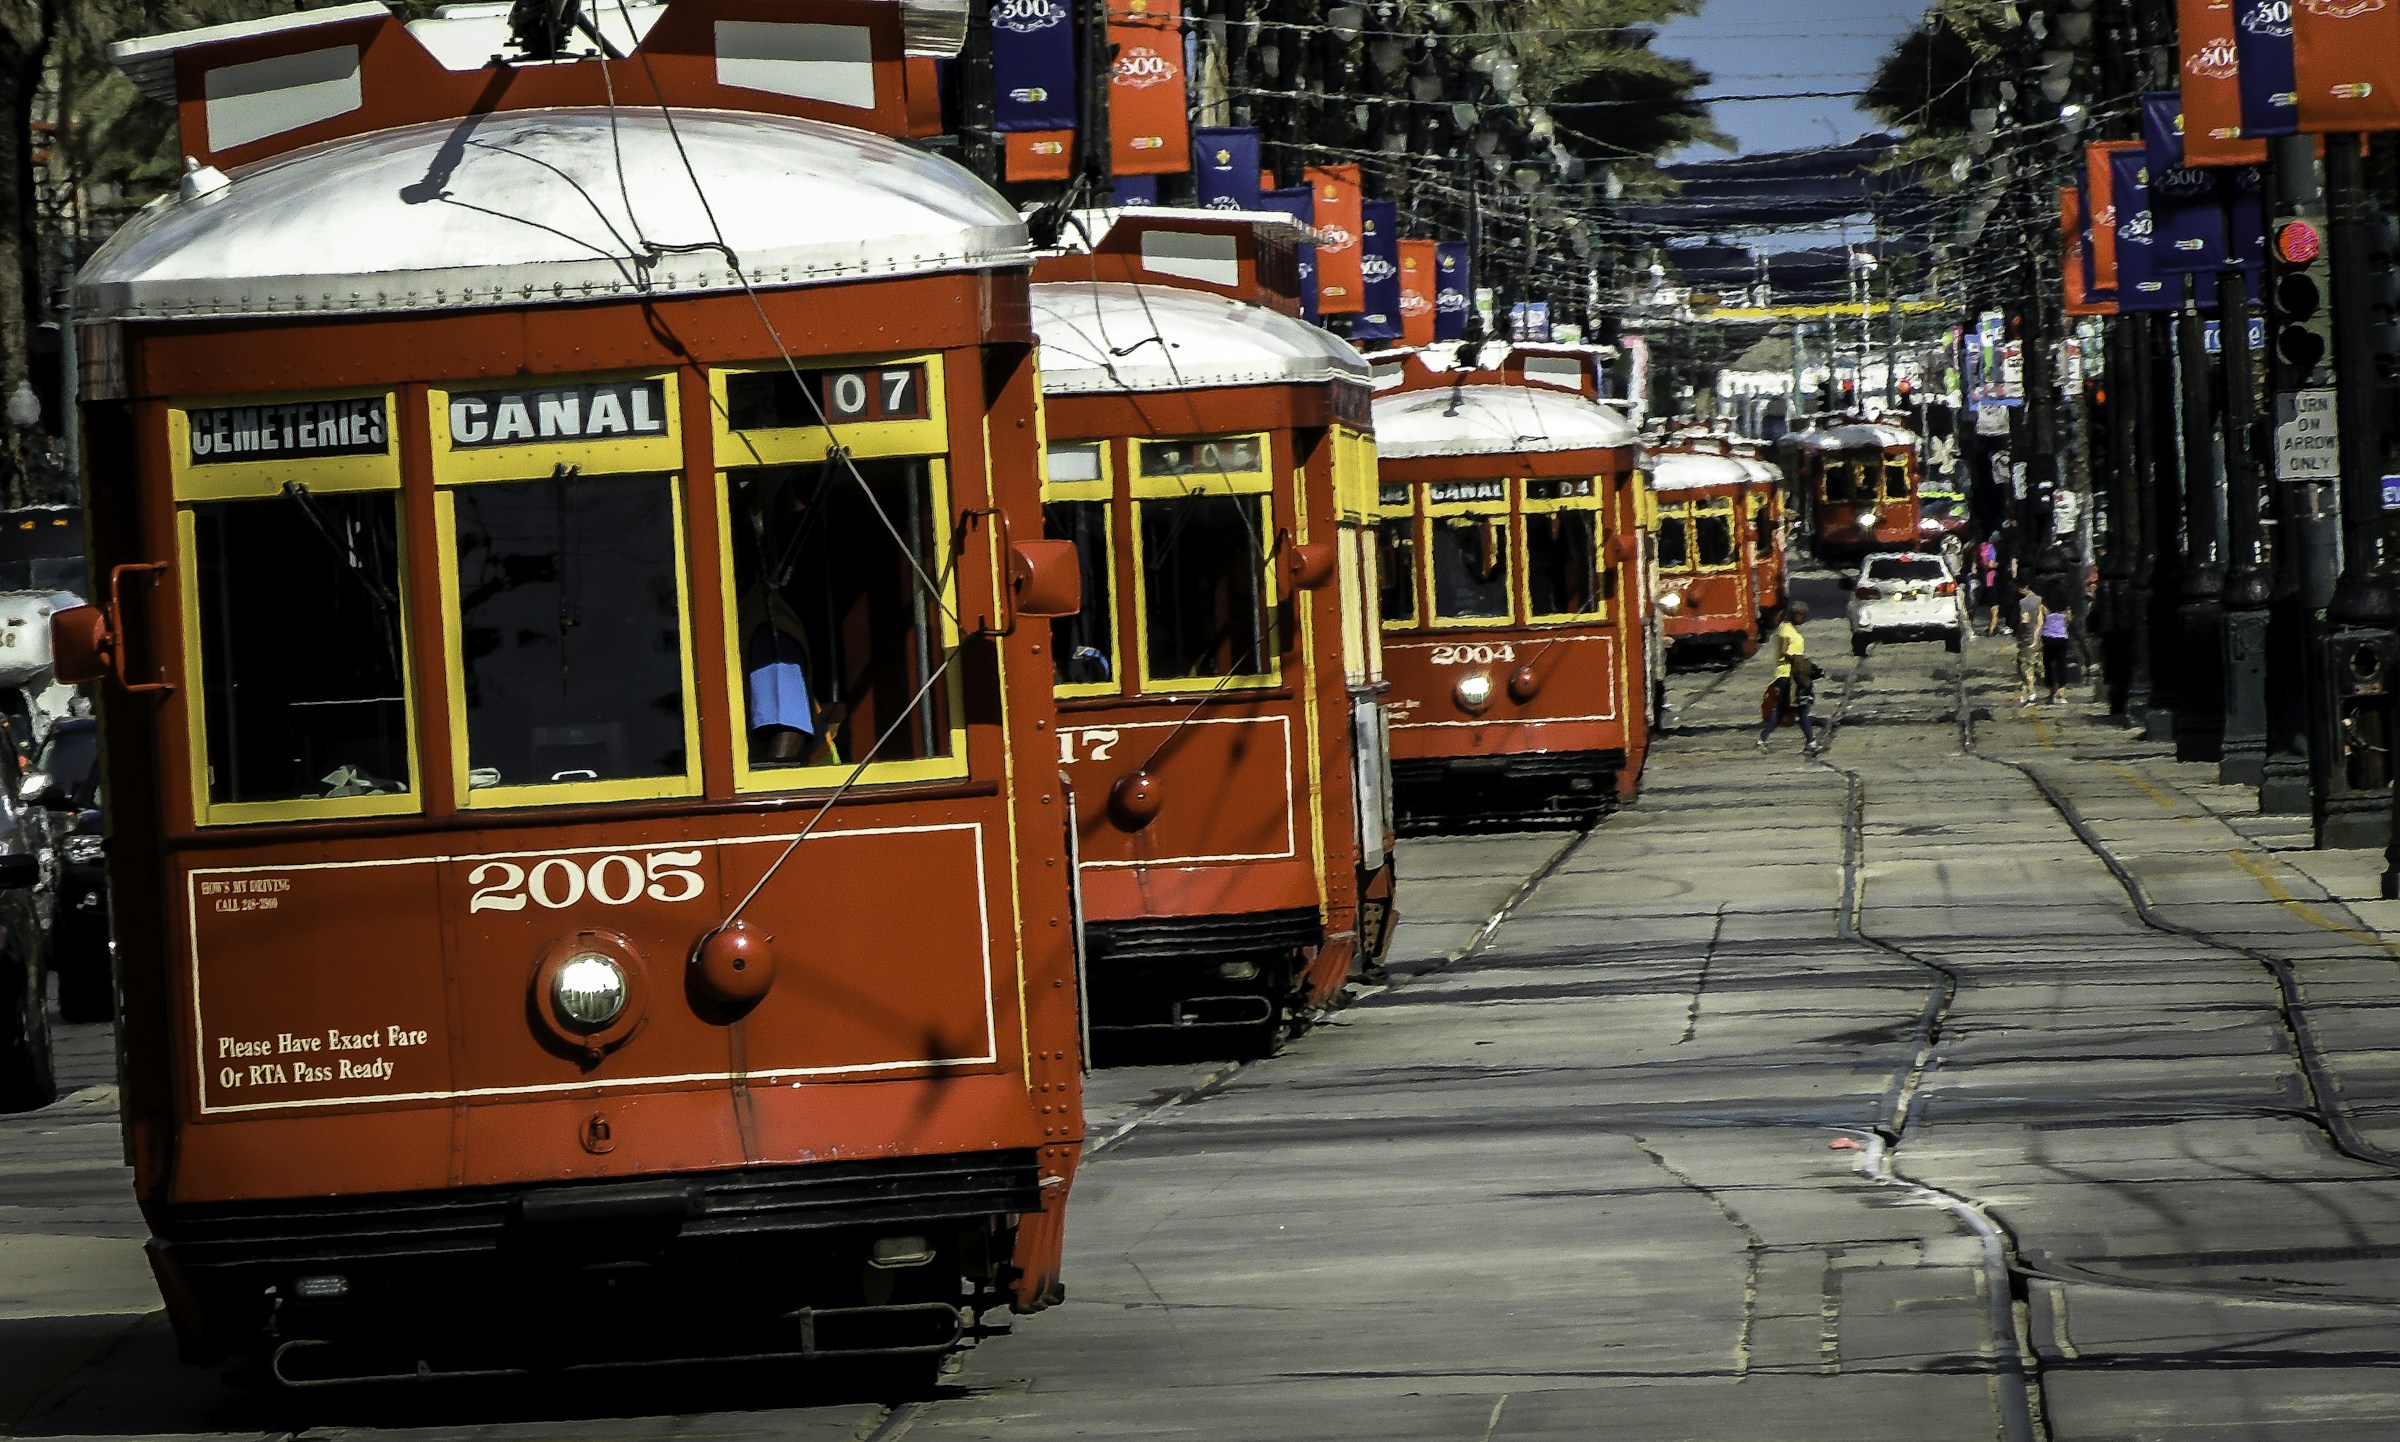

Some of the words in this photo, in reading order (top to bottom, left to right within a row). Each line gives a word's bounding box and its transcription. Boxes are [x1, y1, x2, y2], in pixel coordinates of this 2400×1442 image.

[2257, 0, 2293, 22] 30
[450, 388, 661, 443] CANAL
[2298, 418, 2320, 432] ON
[191, 402, 388, 455] CEMETERIES
[2284, 436, 2336, 450] ARROW
[2291, 457, 2330, 470] ONLY
[1430, 644, 1516, 665] 2004
[249, 878, 290, 893] DRIVING
[468, 850, 705, 914] 2005
[215, 898, 240, 912] CALL
[218, 1036, 272, 1058] Please
[277, 1032, 322, 1054] Have
[328, 1029, 380, 1051] Exact
[387, 1024, 428, 1047] Fare
[219, 1066, 243, 1088] Or
[249, 1063, 288, 1086] RTA
[293, 1061, 333, 1083] Pass
[338, 1056, 394, 1081] Ready
